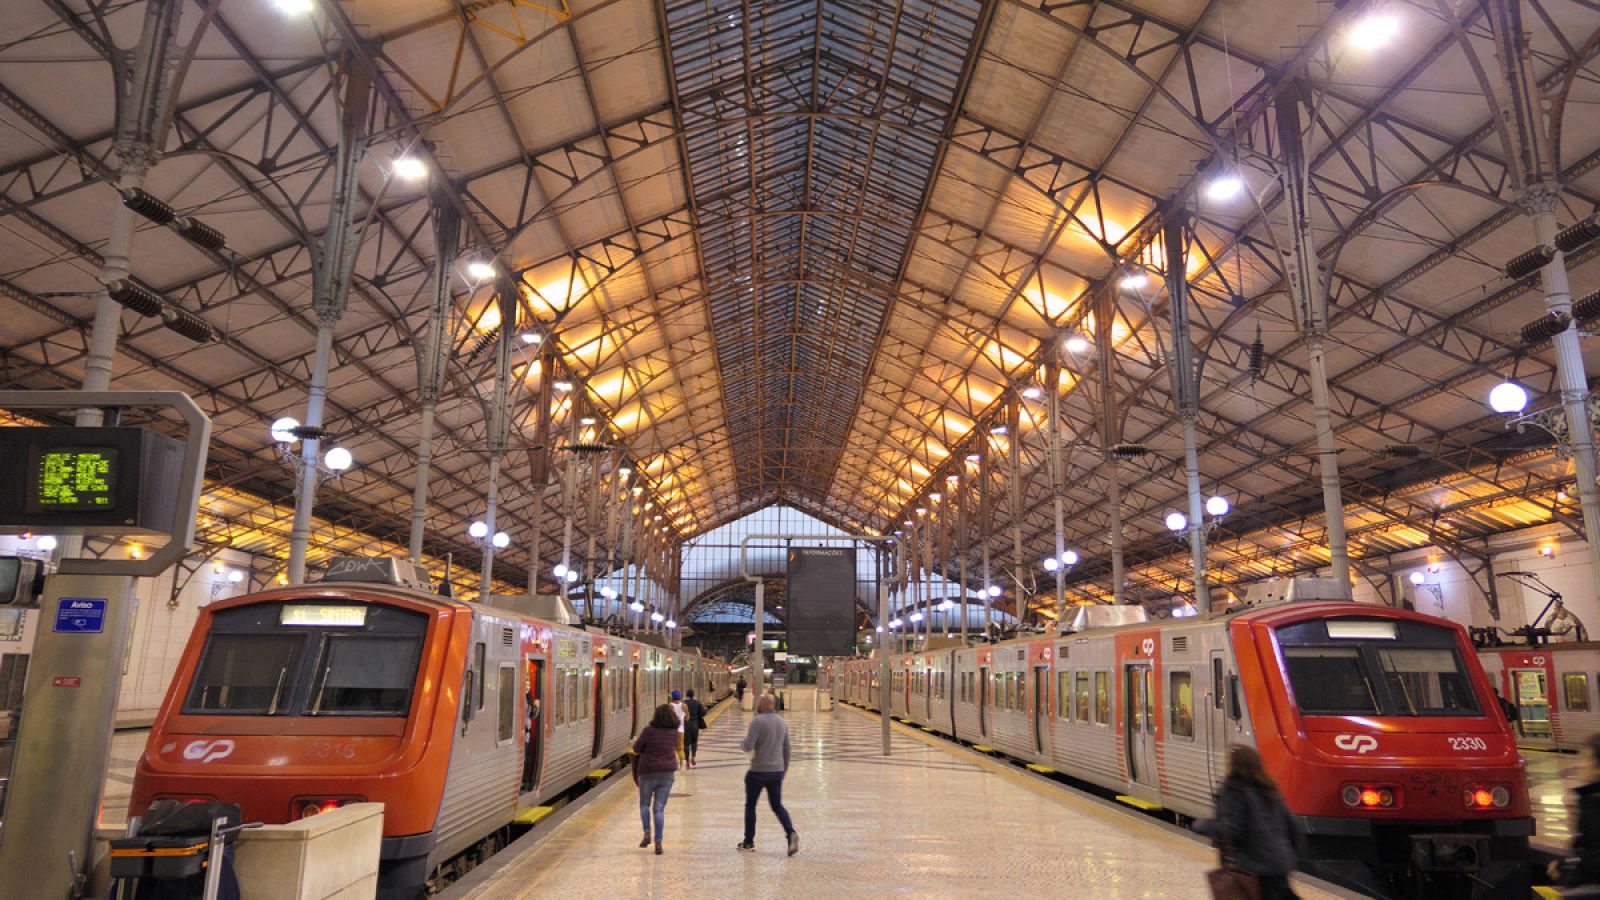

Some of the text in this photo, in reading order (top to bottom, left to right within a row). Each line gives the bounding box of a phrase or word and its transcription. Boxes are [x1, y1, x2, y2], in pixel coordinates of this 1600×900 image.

[71, 601, 93, 609] Aviso
[183, 739, 235, 763] CP
[1334, 734, 1378, 753] CP
[1448, 737, 1487, 750] 2330
